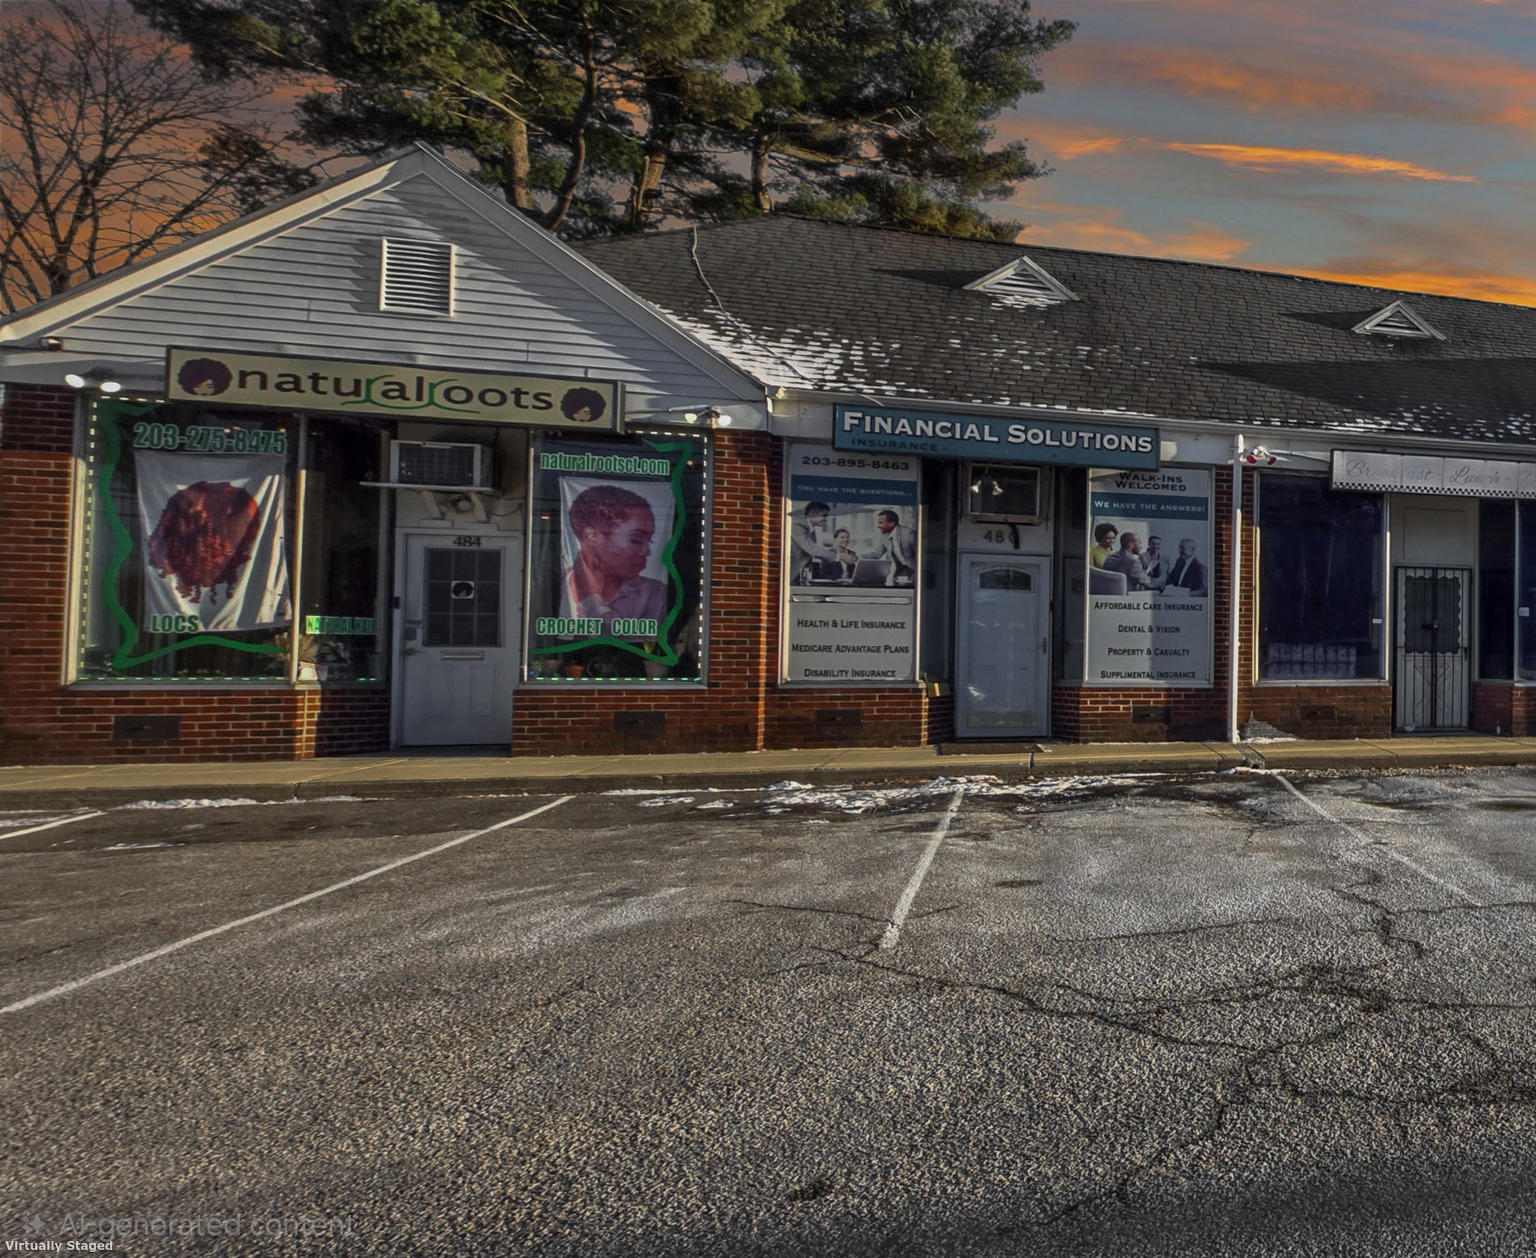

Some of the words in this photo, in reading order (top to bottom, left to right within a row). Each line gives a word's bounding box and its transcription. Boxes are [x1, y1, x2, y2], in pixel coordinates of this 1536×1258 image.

[842, 410, 999, 443] FINANCIAL
[1007, 424, 1154, 453] SOLUTIONS
[133, 422, 287, 456] 203-275-8475
[852, 438, 939, 451] INSURANCE
[540, 452, 670, 475] naturalrootsct.com
[801, 456, 909, 470] 203-895-8463
[1120, 472, 1183, 483] WALK-INS
[1115, 480, 1187, 492] WELCOMED
[1094, 500, 1110, 508] WE
[1160, 504, 1206, 512] ANSWERS!
[453, 535, 482, 548] 484
[1094, 601, 1141, 611] AFFORDABLE
[1143, 602, 1161, 611] CARE
[1164, 602, 1203, 611] INSURANCE
[151, 614, 200, 634] LOCS
[306, 615, 351, 635] NATURAL
[353, 618, 378, 635] HAIR
[536, 617, 604, 636] CROCHET
[611, 617, 658, 636] COLOR
[797, 619, 829, 628] HEALTH
[840, 619, 859, 629] LIFE
[861, 620, 906, 629] INSURANCE
[1118, 624, 1146, 633] DENTAL
[1156, 625, 1181, 633] VISION
[792, 643, 833, 652] MEDICARE
[835, 644, 881, 653] ADVANTAGE
[883, 645, 909, 653] PLANS
[1108, 647, 1144, 656] PROPERTY
[1154, 648, 1190, 656] CASUALTY
[804, 668, 850, 677] DISABILITY
[851, 668, 897, 678] INSURANCE
[1101, 670, 1155, 679] SUPPLIMENTAL
[1157, 671, 1196, 679] INSURANCE
